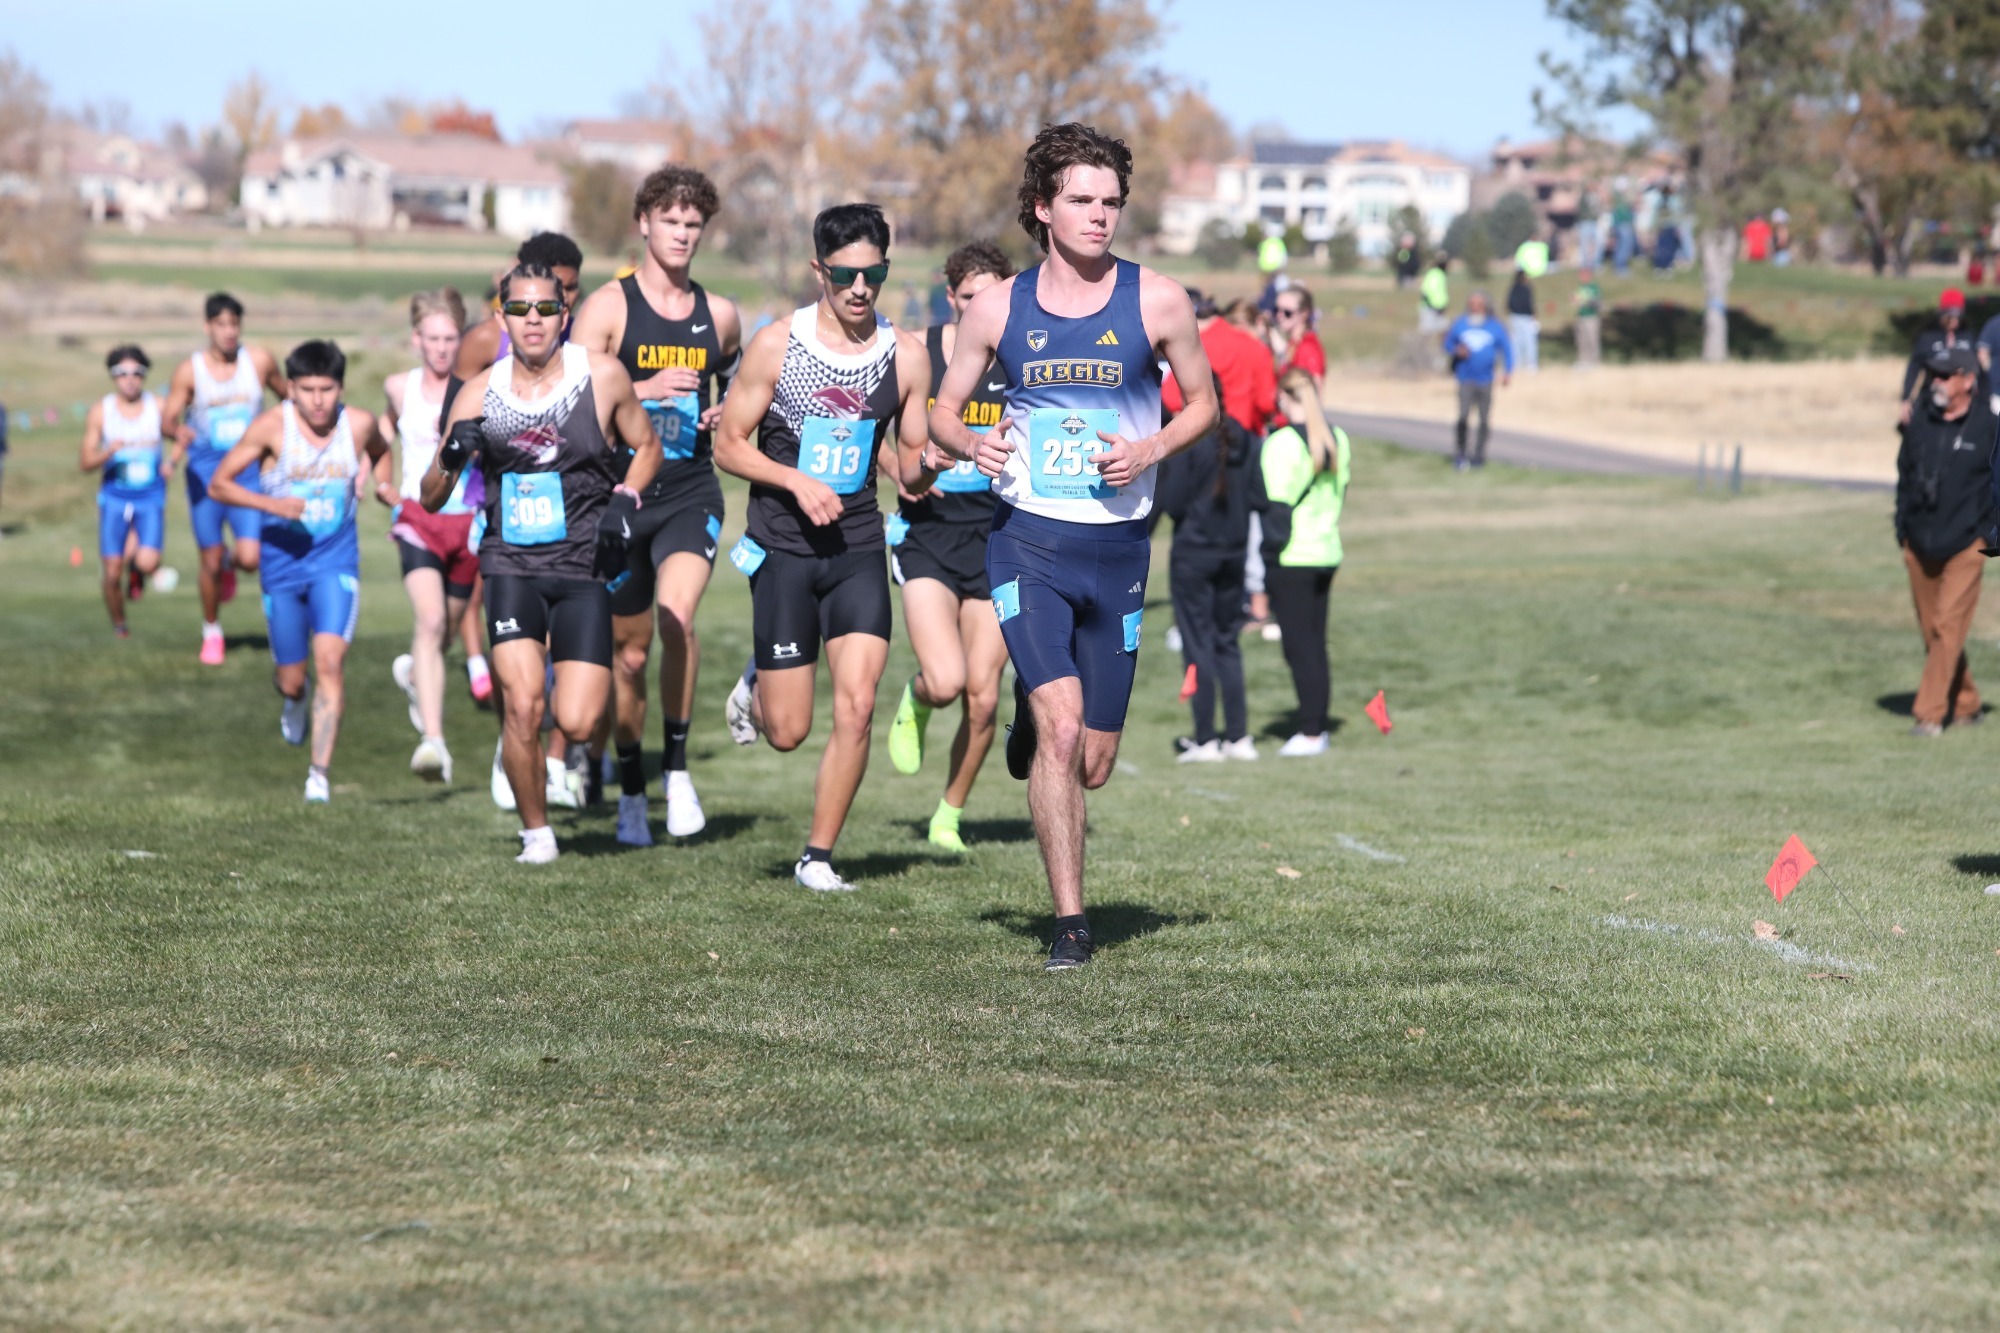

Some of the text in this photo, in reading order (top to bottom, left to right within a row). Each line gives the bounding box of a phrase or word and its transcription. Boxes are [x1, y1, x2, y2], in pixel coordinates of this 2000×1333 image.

[637, 344, 707, 370] CAMERON
[1024, 359, 1122, 388] REGIS
[810, 443, 861, 475] 313
[1043, 438, 1105, 477] 253
[509, 496, 553, 526] 309
